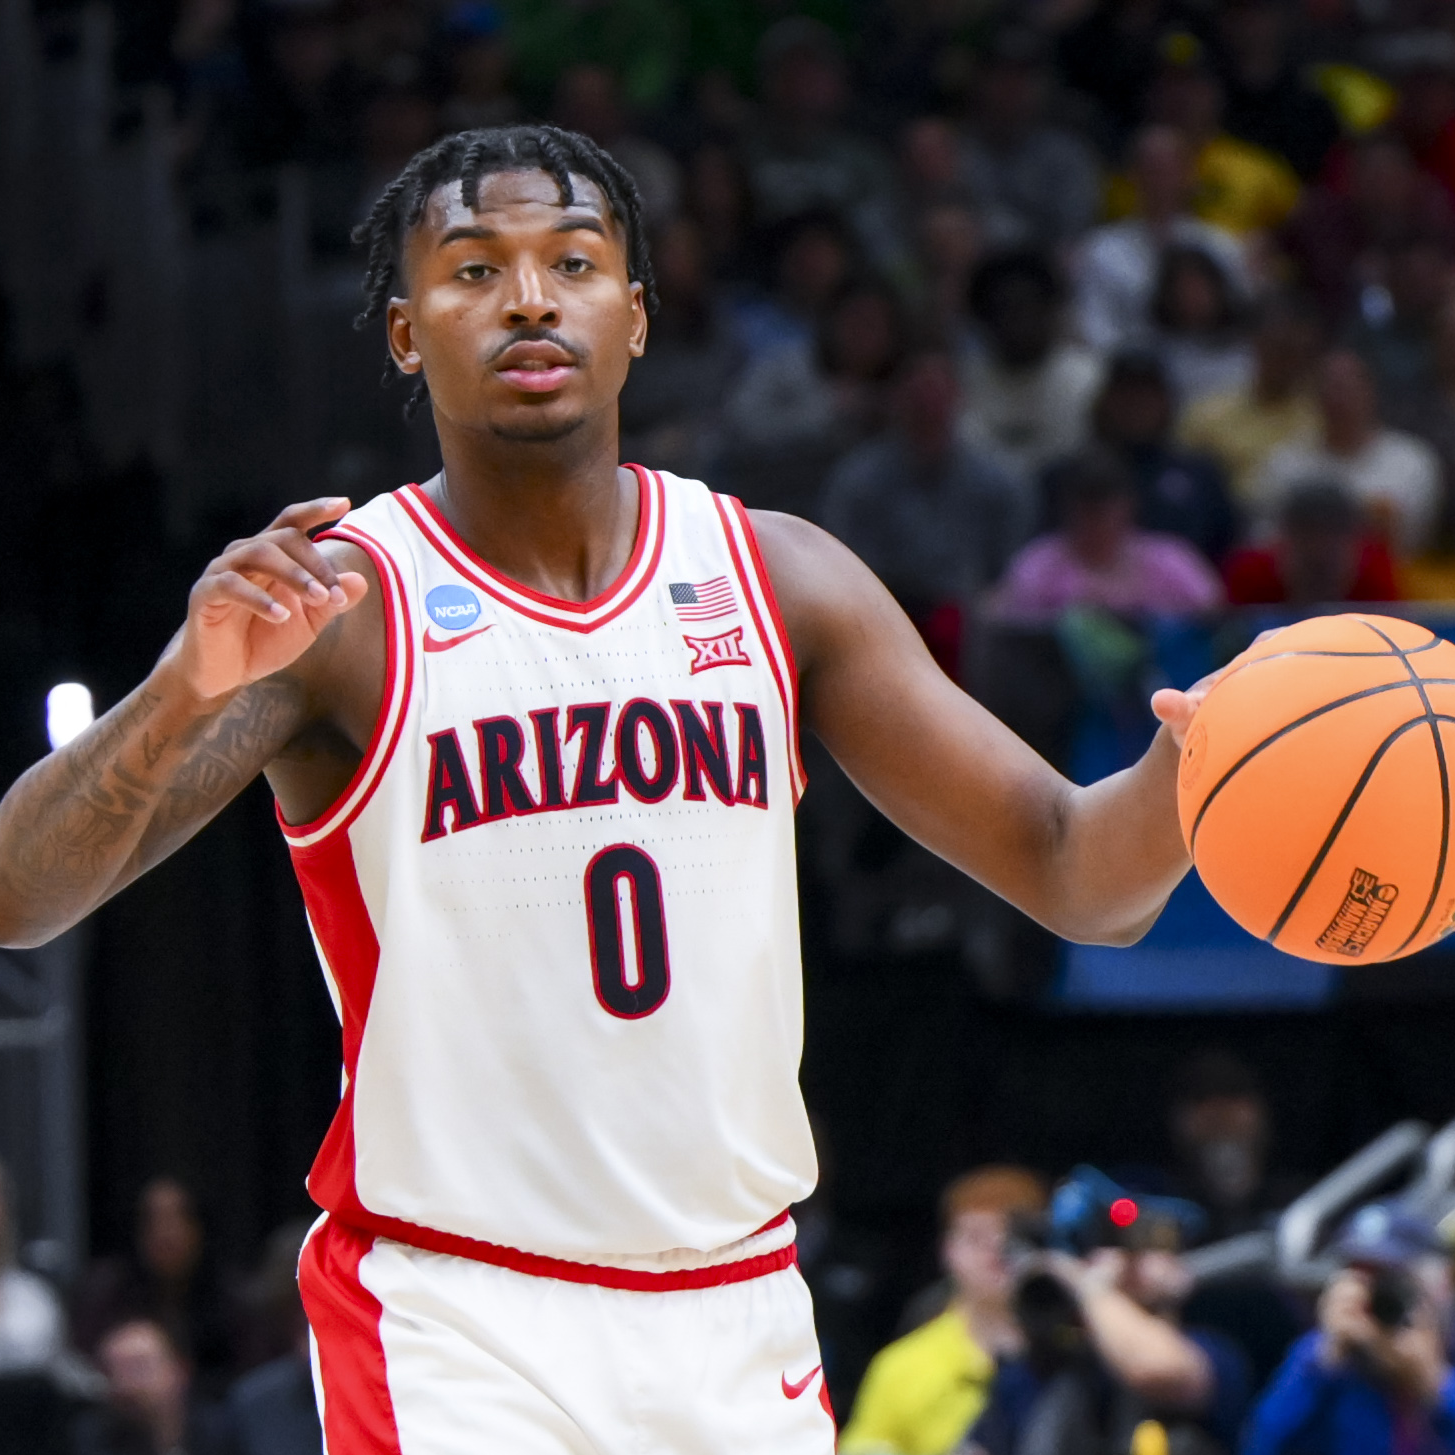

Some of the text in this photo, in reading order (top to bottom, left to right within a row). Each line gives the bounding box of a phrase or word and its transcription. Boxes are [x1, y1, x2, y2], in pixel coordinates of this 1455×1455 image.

[434, 603, 478, 618] NCAA
[686, 629, 749, 670] XII
[420, 697, 768, 843] ARIZONA
[584, 842, 671, 1020] 0
